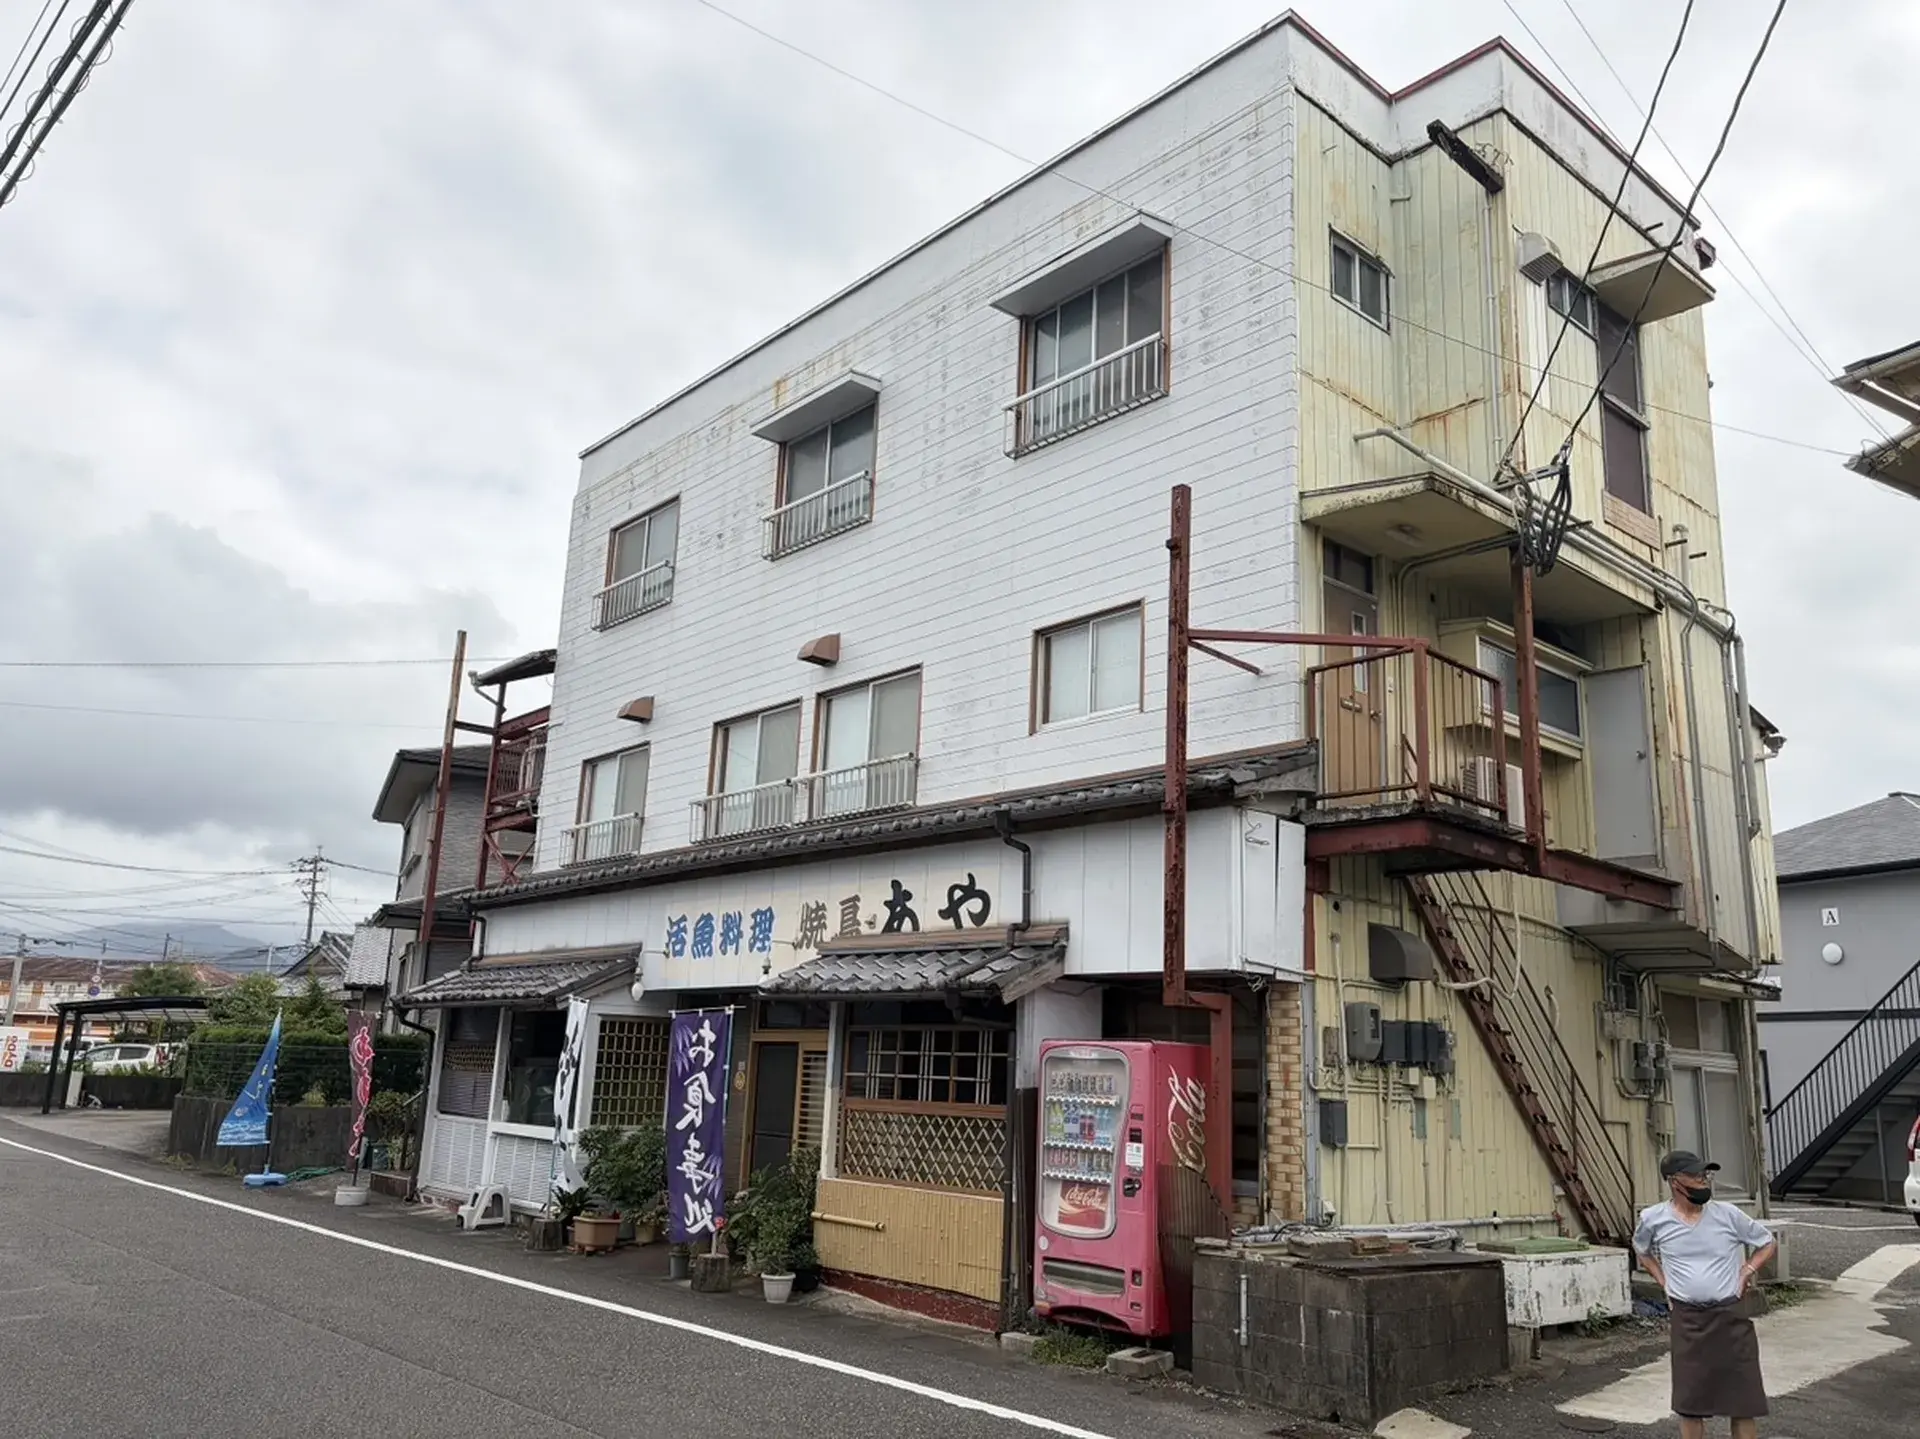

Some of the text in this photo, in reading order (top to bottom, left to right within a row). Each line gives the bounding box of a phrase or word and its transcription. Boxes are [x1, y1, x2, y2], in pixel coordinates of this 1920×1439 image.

[666, 906, 774, 959] 活魚料理
[881, 871, 991, 933] あや
[1826, 910, 1837, 924] A
[676, 1019, 716, 1234] お食事処
